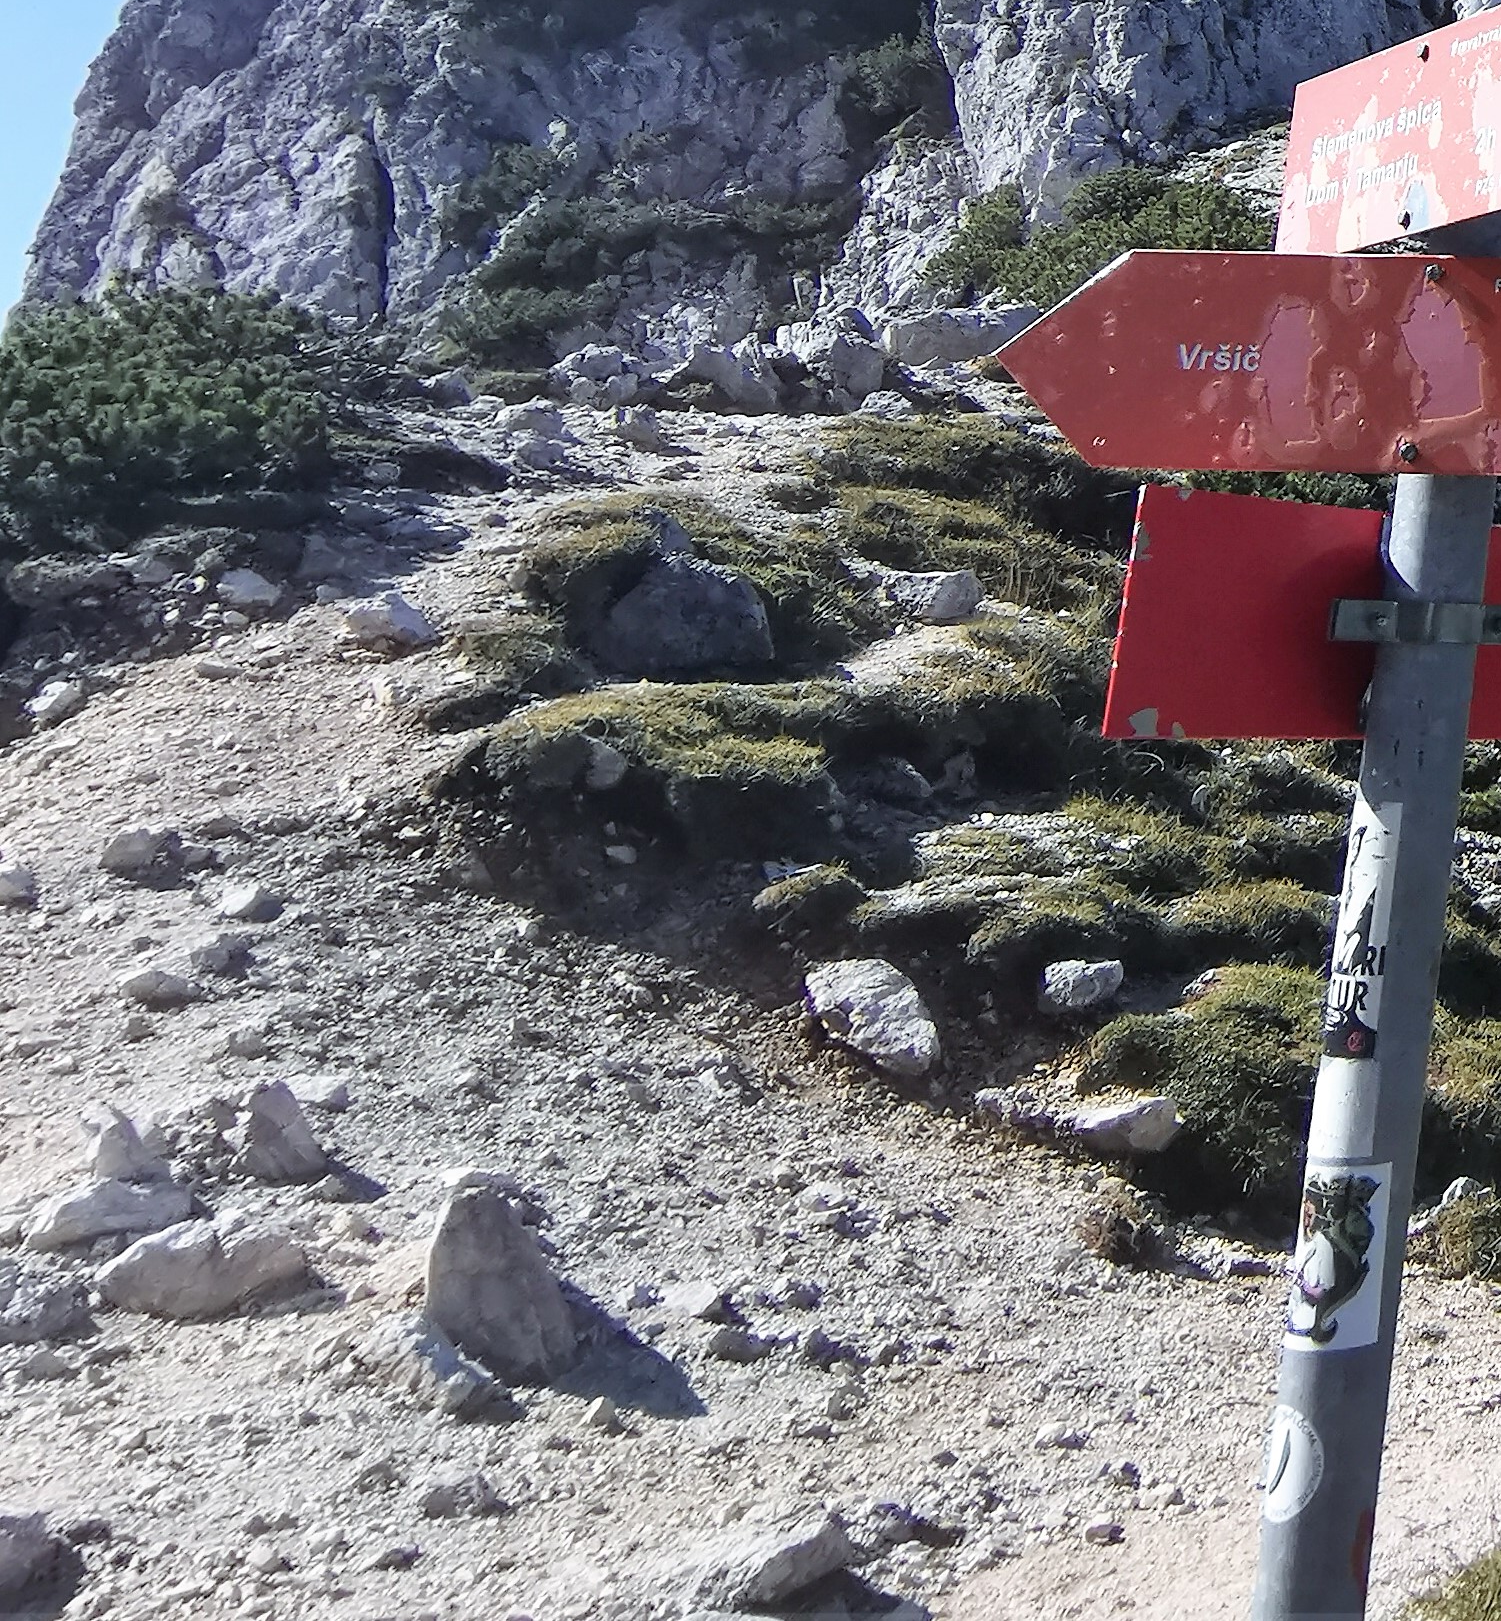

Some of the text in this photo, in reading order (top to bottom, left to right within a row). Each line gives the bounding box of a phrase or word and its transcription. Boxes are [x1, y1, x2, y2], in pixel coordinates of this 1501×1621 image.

[1311, 98, 1442, 160] Slemenova špica
[1474, 126, 1496, 155] 2h
[1305, 180, 1340, 208] Dom
[1179, 343, 1261, 372] Vršič
